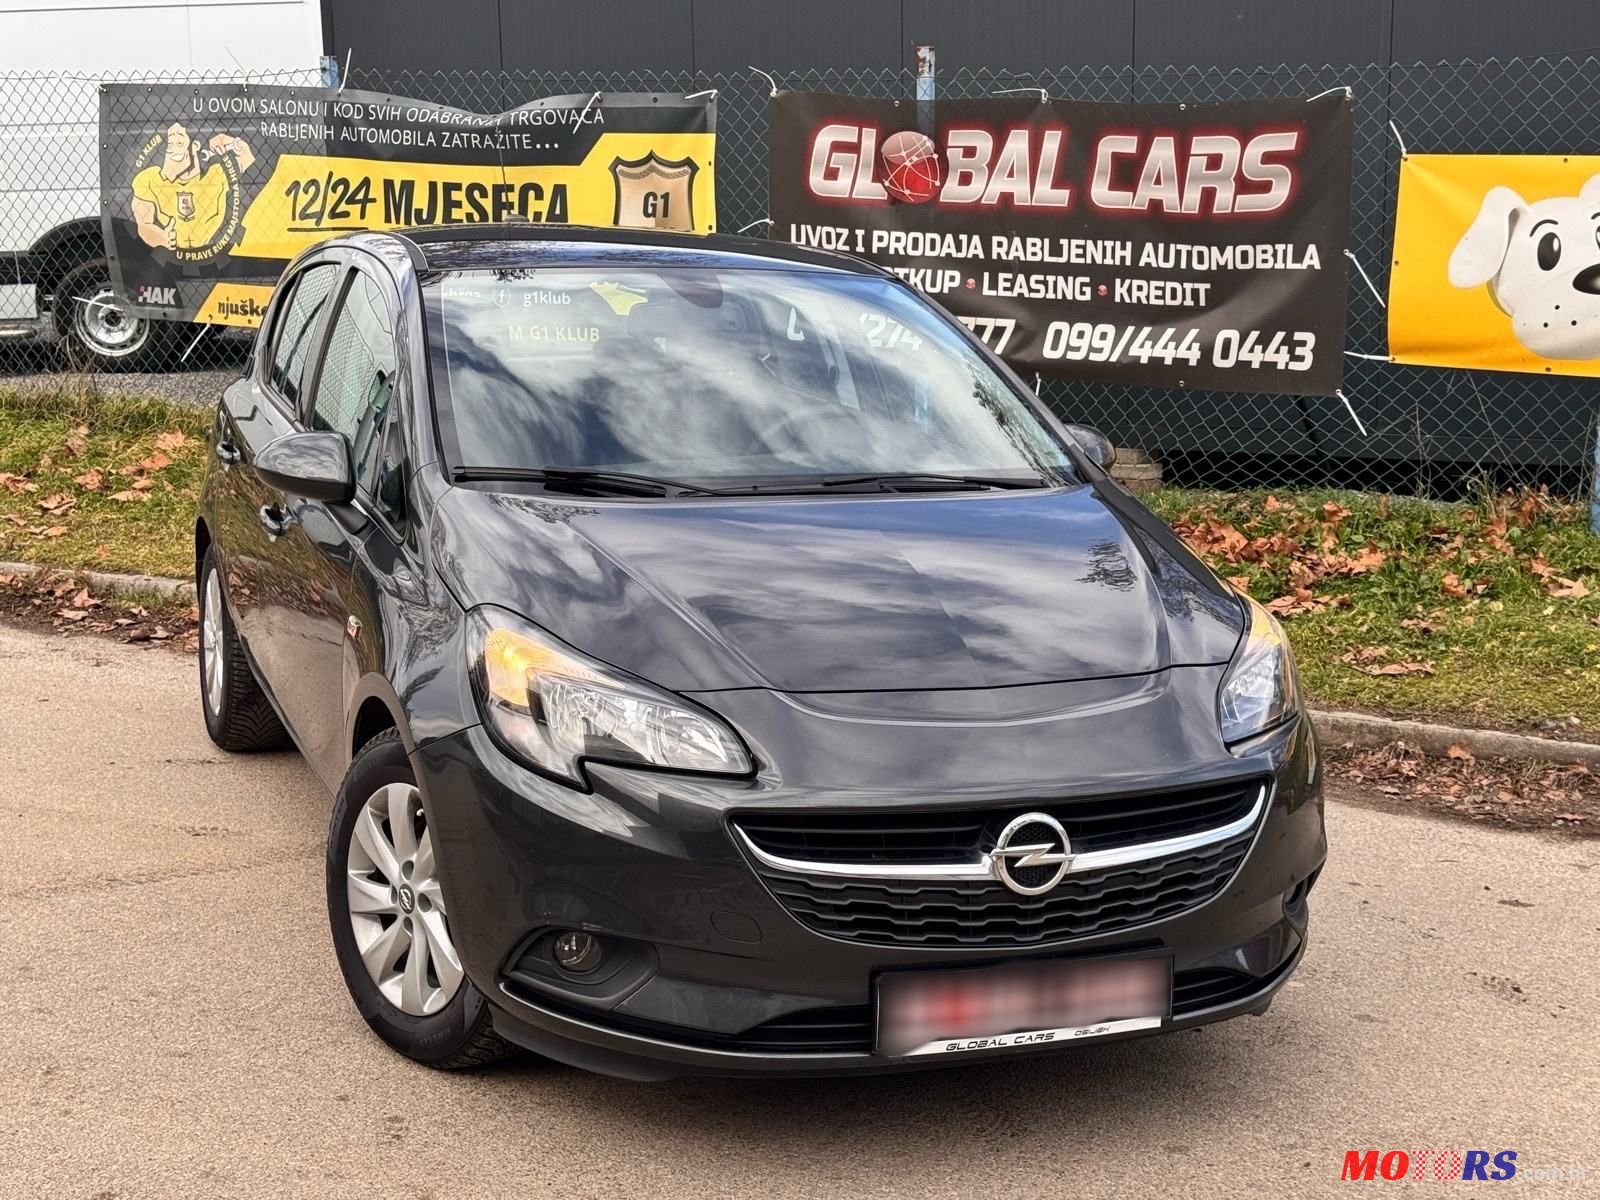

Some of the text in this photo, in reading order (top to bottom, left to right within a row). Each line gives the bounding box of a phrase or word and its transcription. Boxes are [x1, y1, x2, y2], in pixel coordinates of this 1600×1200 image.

[193, 97, 204, 113] U
[208, 97, 256, 113] OVOM
[260, 99, 319, 117] SALONU
[323, 101, 328, 117] I
[333, 102, 364, 120] KOD
[368, 104, 401, 121] SVIH
[509, 108, 605, 126] TRGOVACA
[144, 134, 163, 157] KLUB
[260, 121, 335, 142] RABLJENIH
[340, 127, 437, 147] AUTOMOBILA
[1089, 131, 1300, 214] CARS
[284, 170, 570, 226] 12/24 MJESECA
[642, 191, 672, 219] G1
[185, 250, 213, 261] PRAVE
[213, 235, 231, 256] RUKE
[226, 186, 240, 238] MAJSTORA
[790, 223, 1322, 271] UVOZ I PRODAJA RABLJENIH AUTOMOBILA
[138, 285, 177, 306] HAK
[522, 290, 572, 308] g1klub
[885, 266, 1211, 307] TKUP LEASING KREDIT
[529, 325, 549, 340] G1
[555, 326, 600, 342] KLUB
[1042, 320, 1202, 367] 099/444
[1211, 328, 1317, 371] 0443
[945, 1037, 1008, 1052] GLOBAL
[1013, 1032, 1056, 1046] CARS
